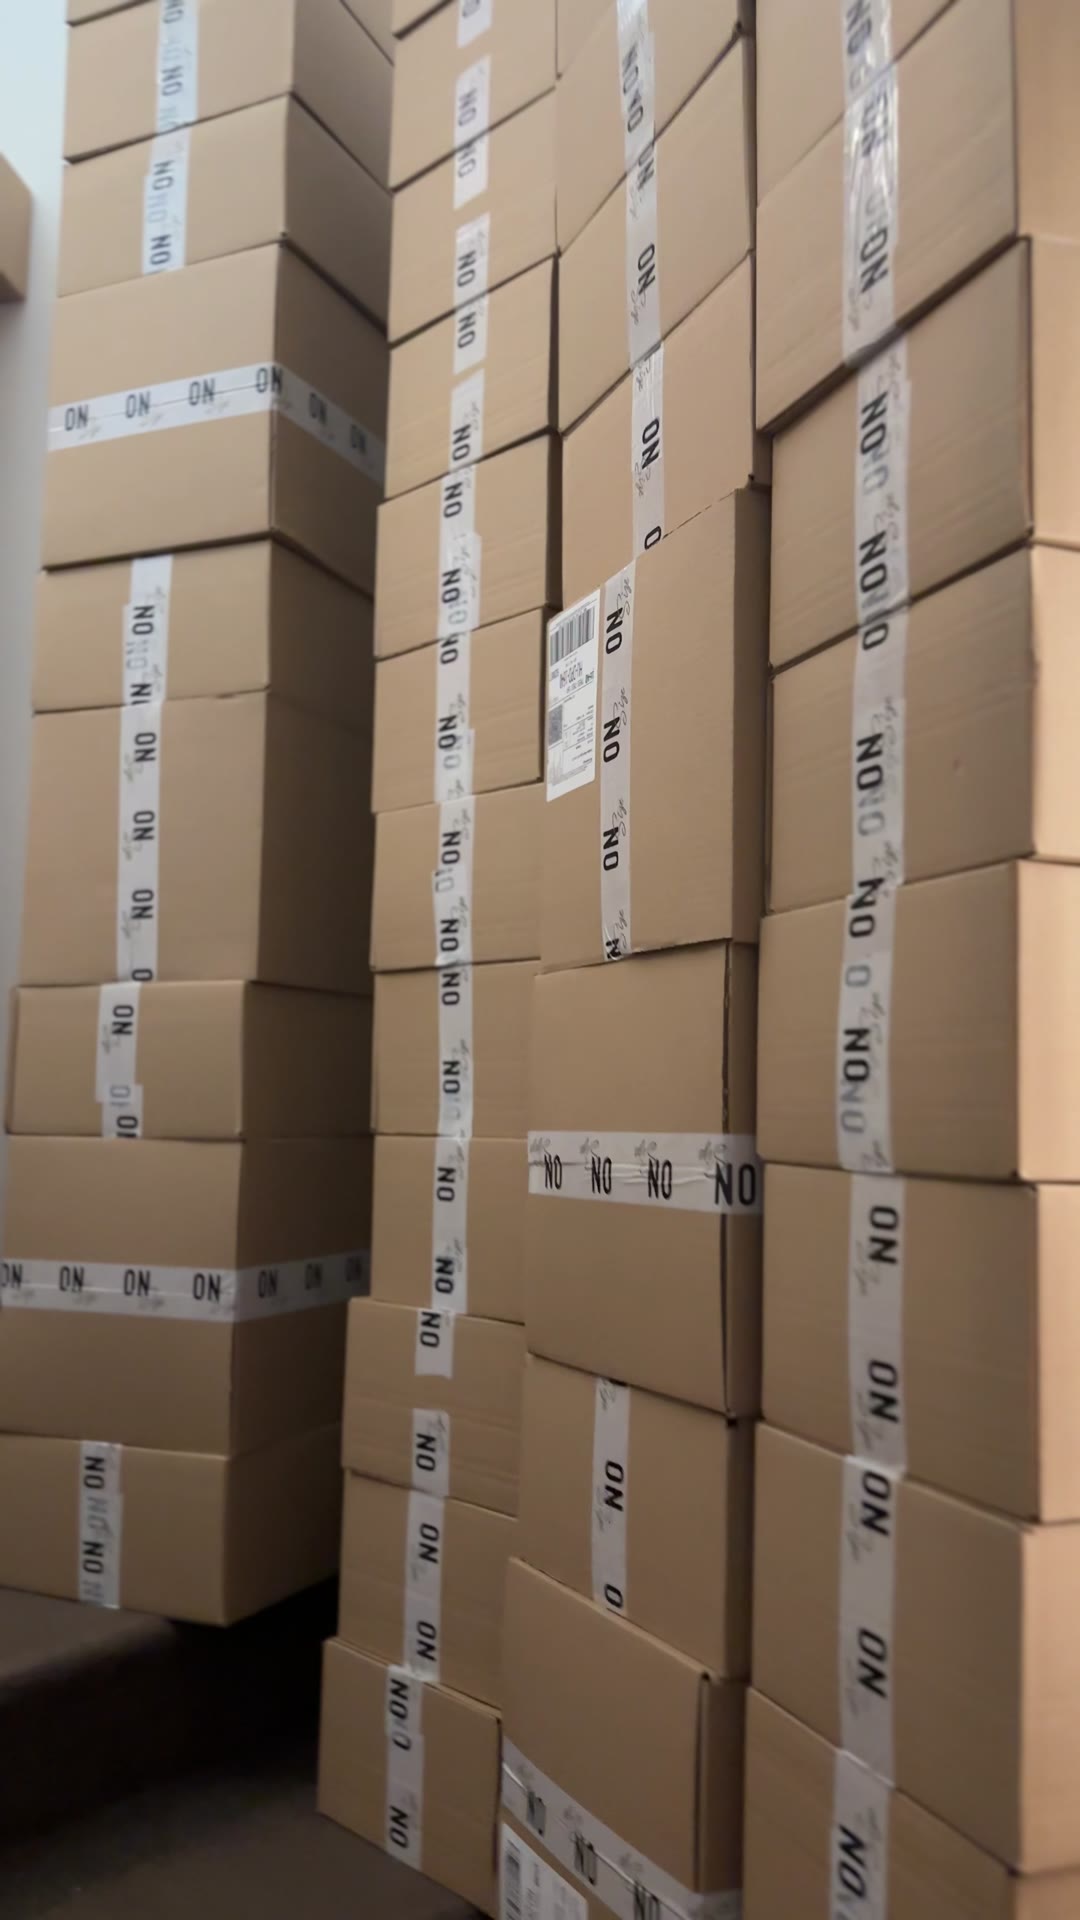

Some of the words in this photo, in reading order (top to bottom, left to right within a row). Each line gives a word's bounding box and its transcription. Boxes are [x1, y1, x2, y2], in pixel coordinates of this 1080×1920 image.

[65, 404, 88, 431] ON
[126, 391, 150, 419] ON
[189, 378, 215, 406] ON
[256, 366, 283, 394] ON
[59, 1266, 84, 1293] ON
[124, 1269, 151, 1297] ON
[193, 1272, 221, 1302] ON
